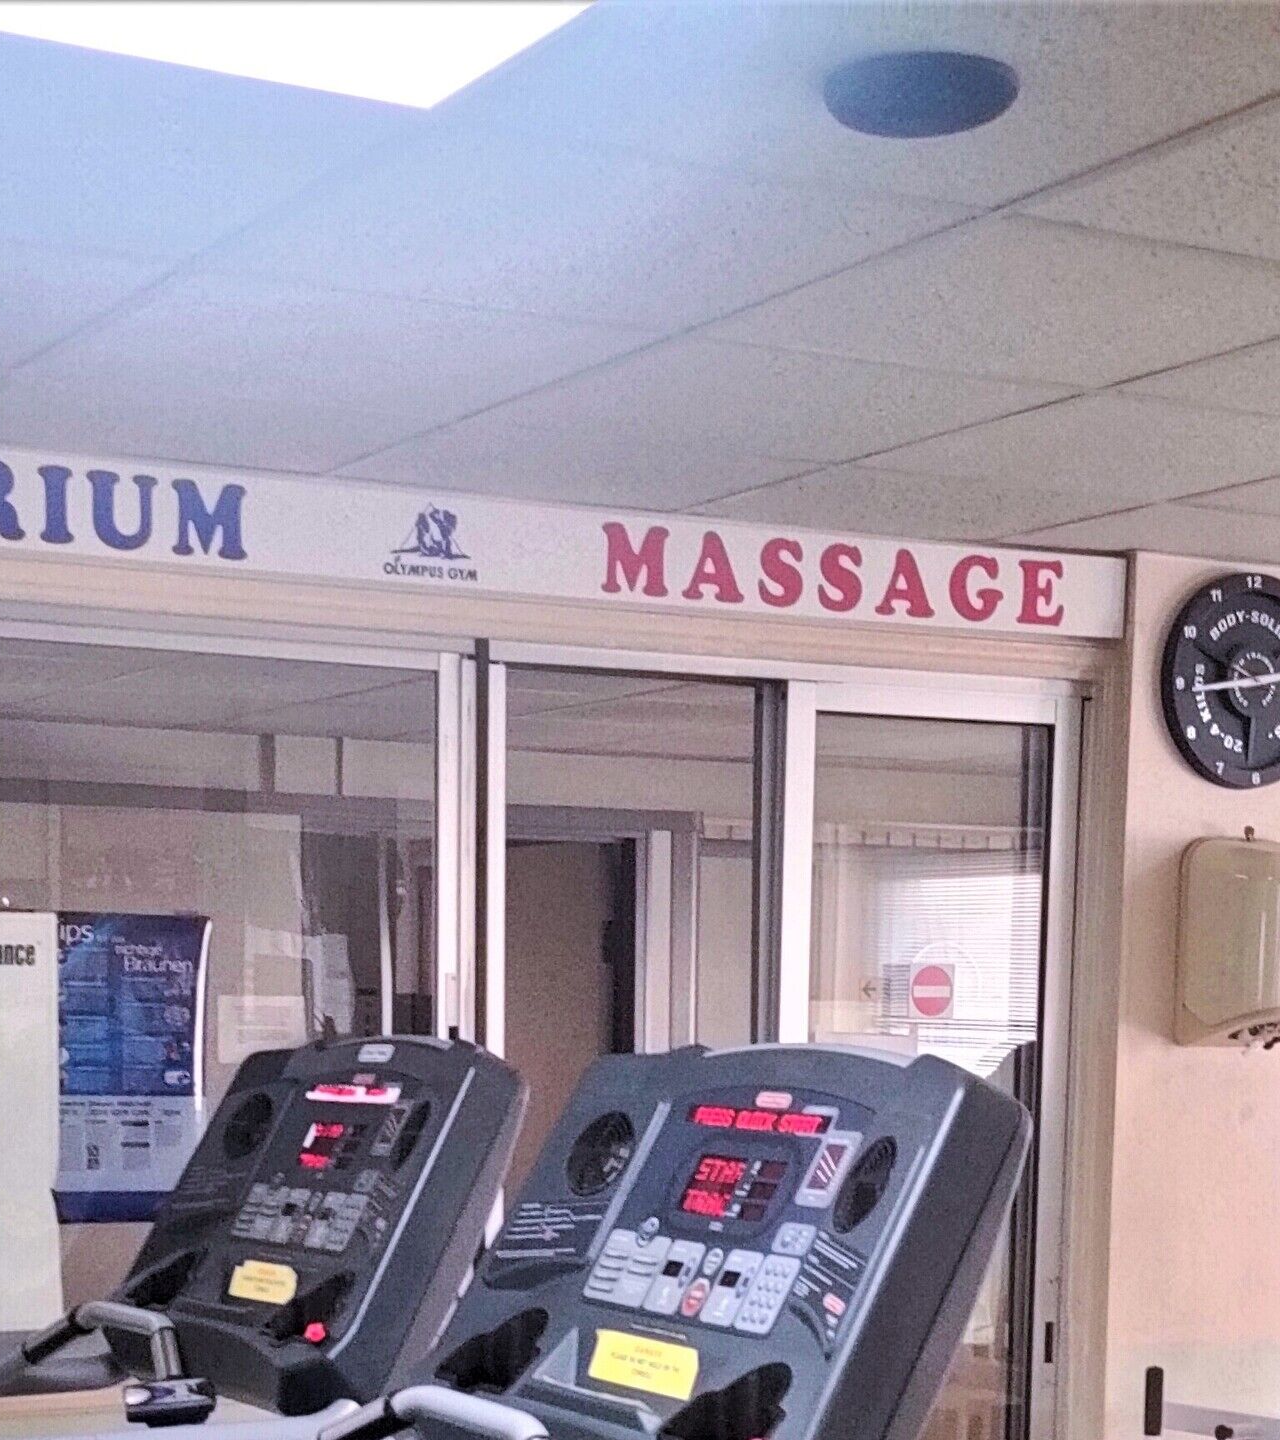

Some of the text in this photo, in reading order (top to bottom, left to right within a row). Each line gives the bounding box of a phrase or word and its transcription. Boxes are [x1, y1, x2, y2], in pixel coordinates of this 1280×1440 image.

[383, 562, 478, 581] OLYMPUS GYM
[601, 521, 1066, 627] MASSAGE
[1246, 575, 1262, 589] 12
[1211, 588, 1223, 602] 11
[1184, 625, 1197, 640] 10
